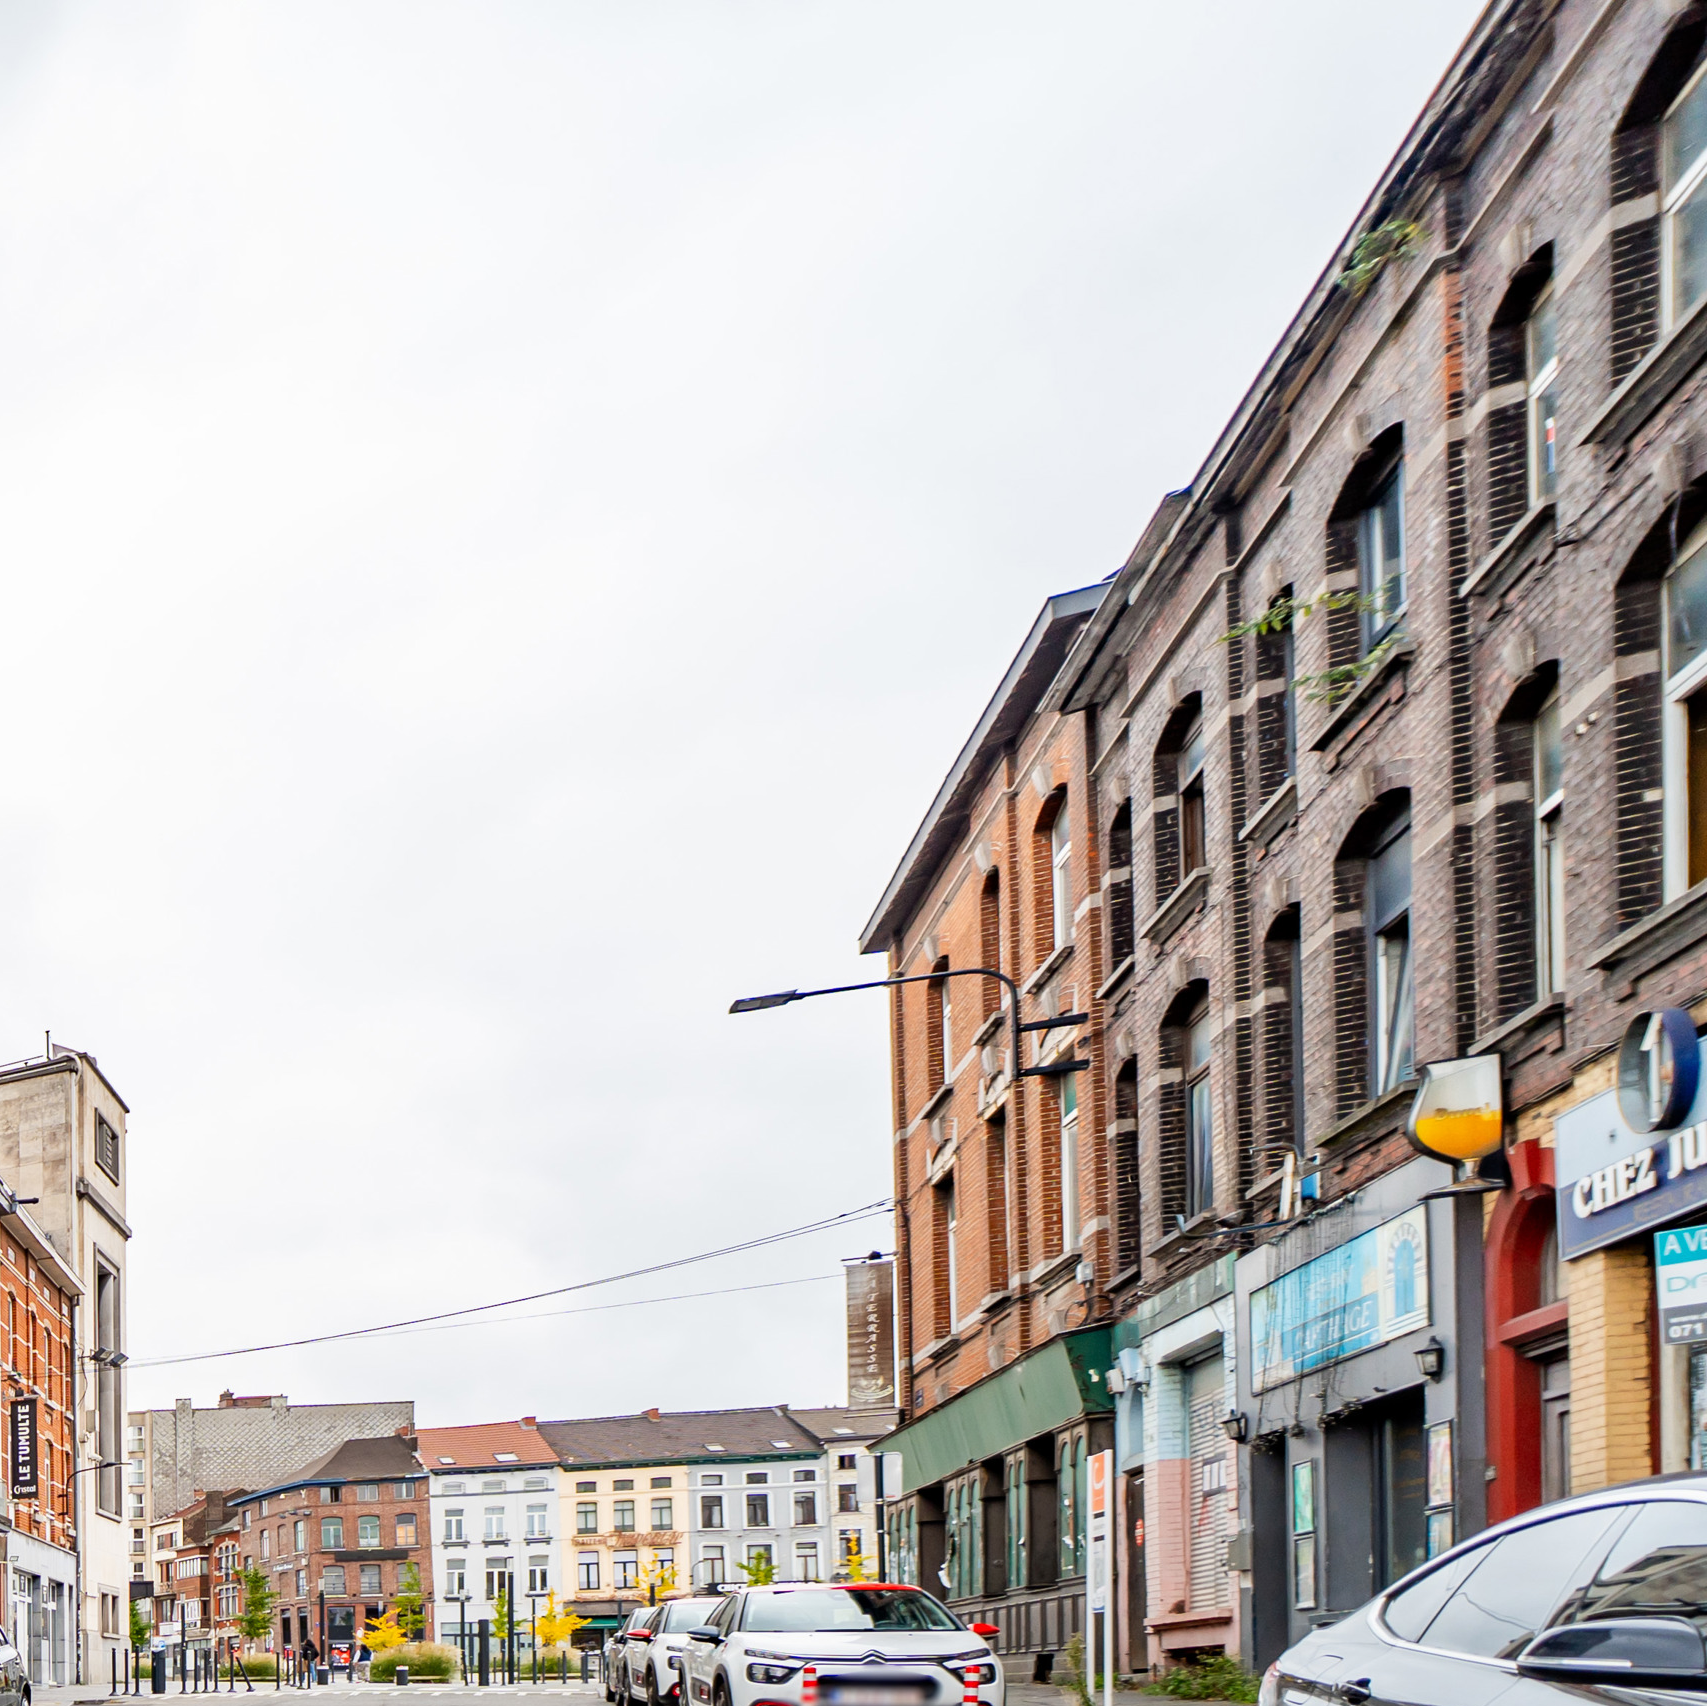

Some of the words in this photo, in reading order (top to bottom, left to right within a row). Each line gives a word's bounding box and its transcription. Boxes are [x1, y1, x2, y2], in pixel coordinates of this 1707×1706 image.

[1573, 1147, 1657, 1219] CHEZ
[1663, 1233, 1682, 1256] A
[864, 1292, 880, 1373] TERRASSE
[1668, 1322, 1704, 1339] 071
[17, 1404, 31, 1463] TUMULTE
[19, 1465, 31, 1481] LE
